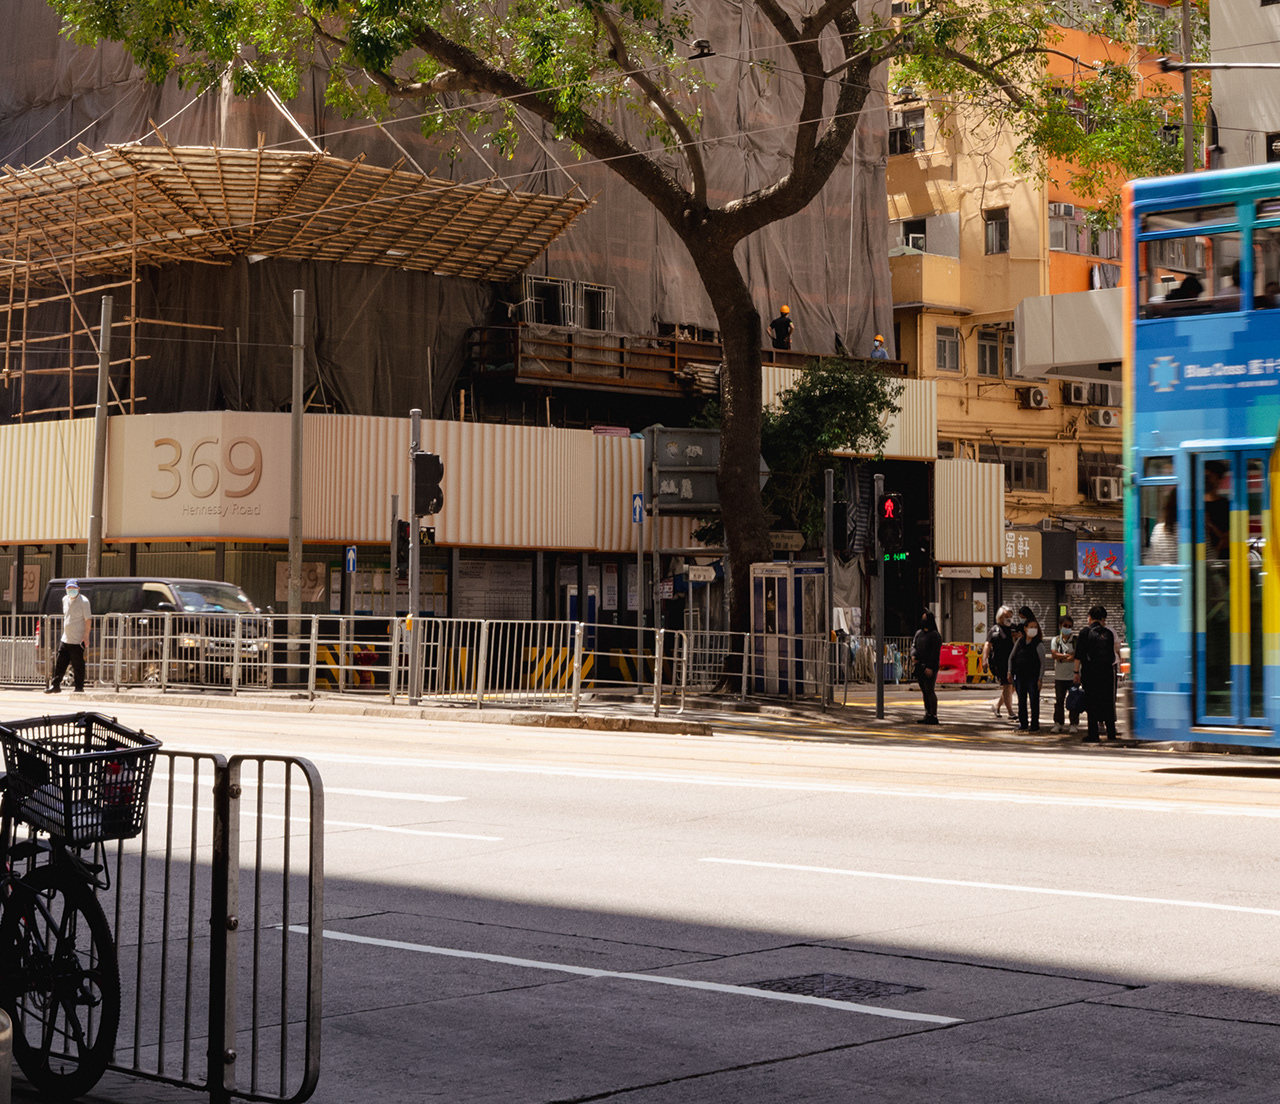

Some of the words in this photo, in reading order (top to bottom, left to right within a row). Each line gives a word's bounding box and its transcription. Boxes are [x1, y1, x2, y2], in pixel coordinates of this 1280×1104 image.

[150, 436, 263, 500] 369
[182, 504, 228, 517] Hennessy
[232, 503, 261, 516] Road
